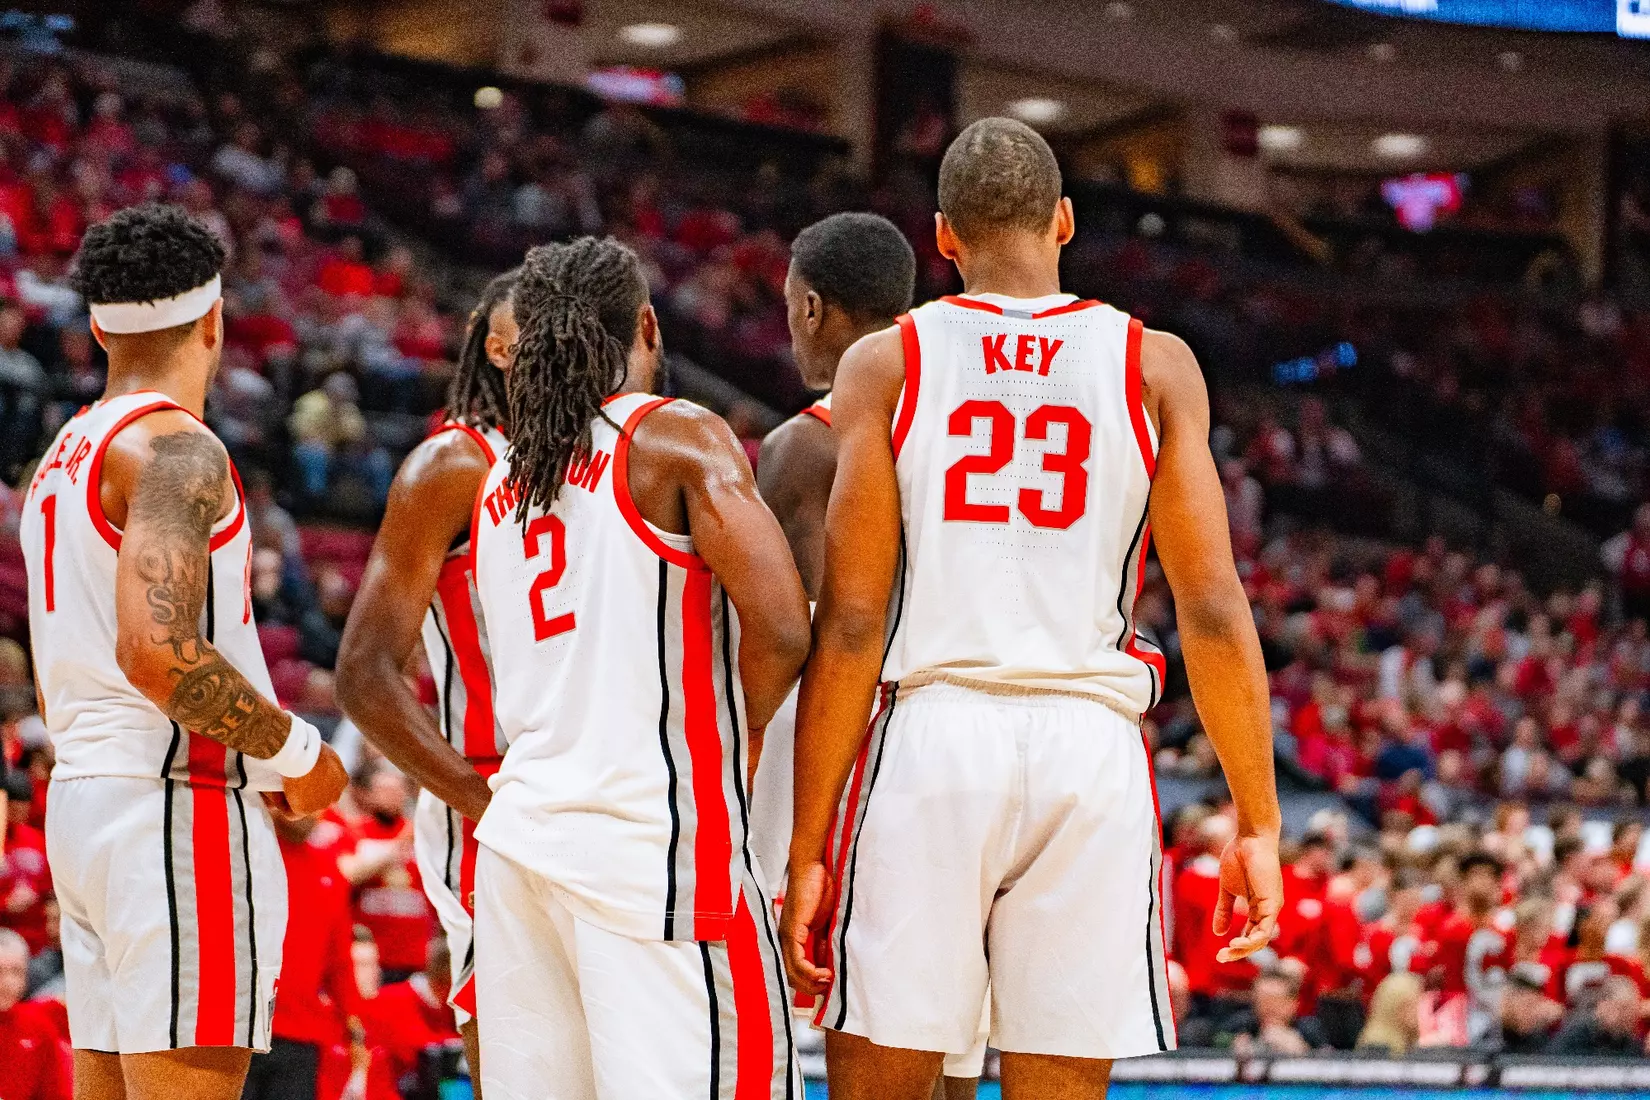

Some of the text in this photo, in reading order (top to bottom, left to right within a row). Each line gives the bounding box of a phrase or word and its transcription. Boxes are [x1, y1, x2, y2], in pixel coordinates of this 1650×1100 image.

[981, 333, 1064, 377] KEY
[943, 399, 1092, 530] 23
[41, 494, 57, 613] 1
[524, 513, 577, 641] 2
